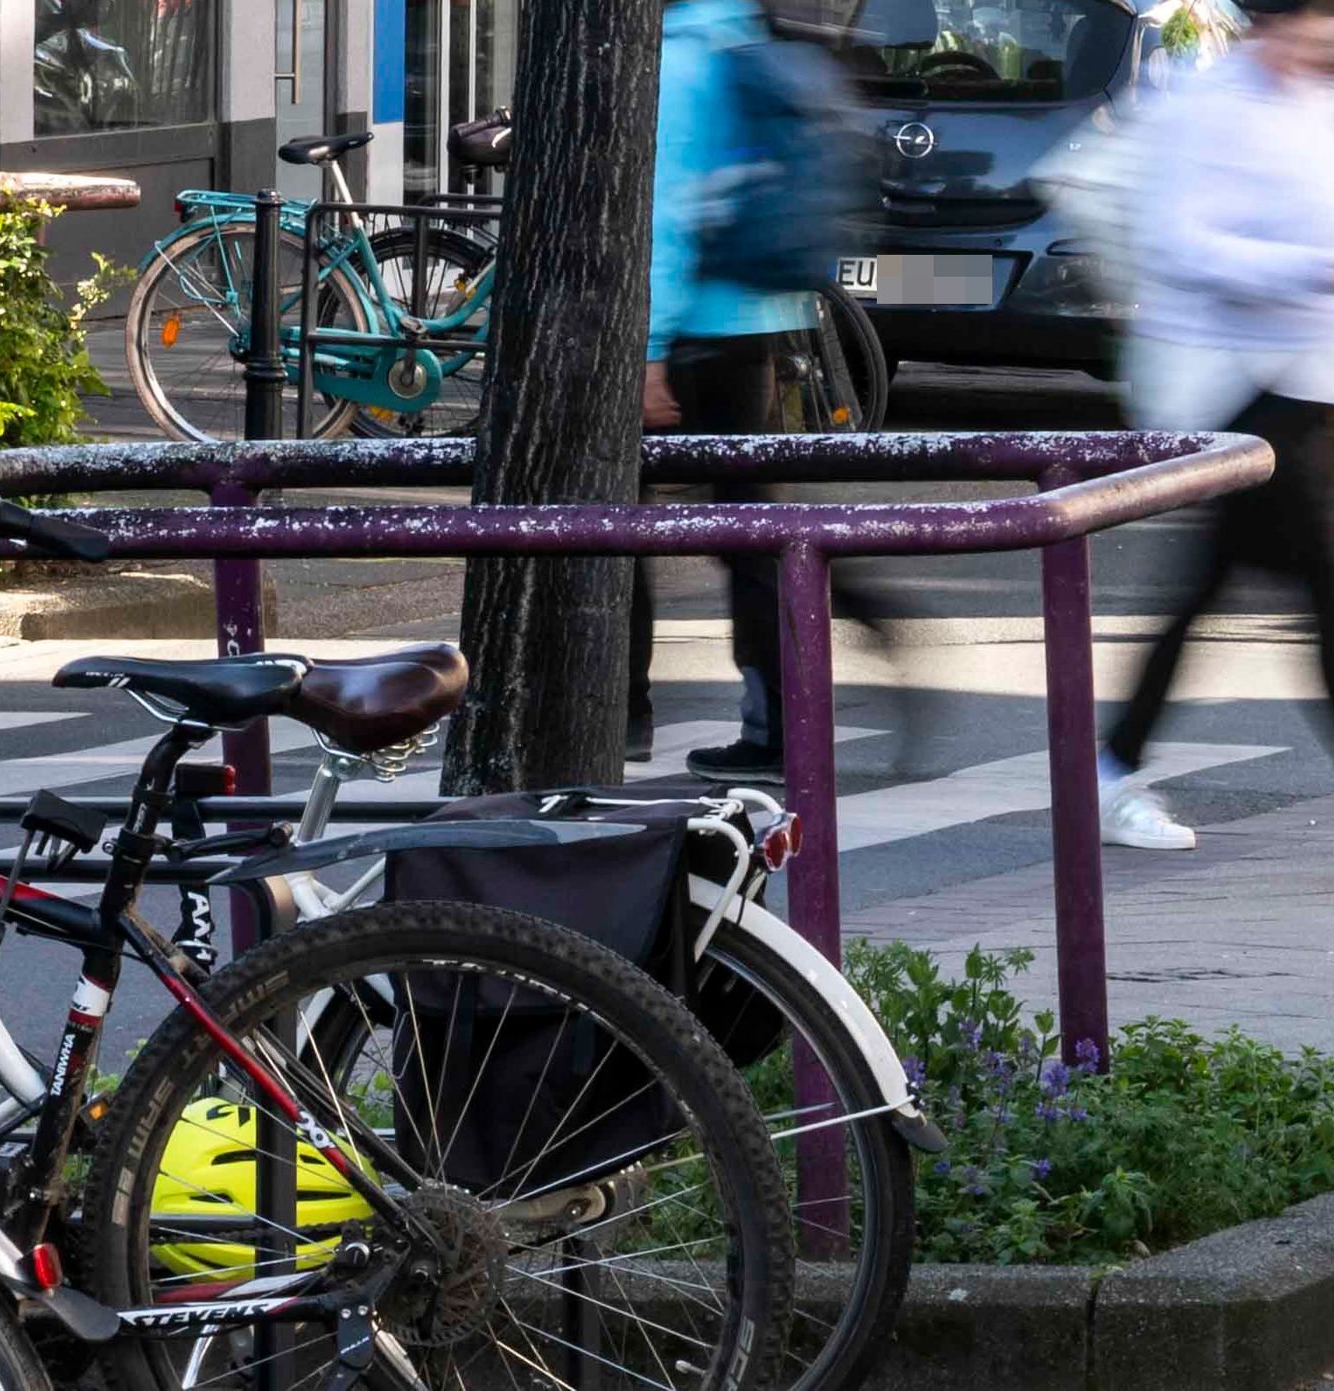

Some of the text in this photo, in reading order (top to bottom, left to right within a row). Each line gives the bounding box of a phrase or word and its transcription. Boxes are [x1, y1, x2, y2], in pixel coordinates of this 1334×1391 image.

[838, 259, 875, 287] EU
[49, 1033, 76, 1097] TANIWHA
[131, 1303, 270, 1331] STEVENS
